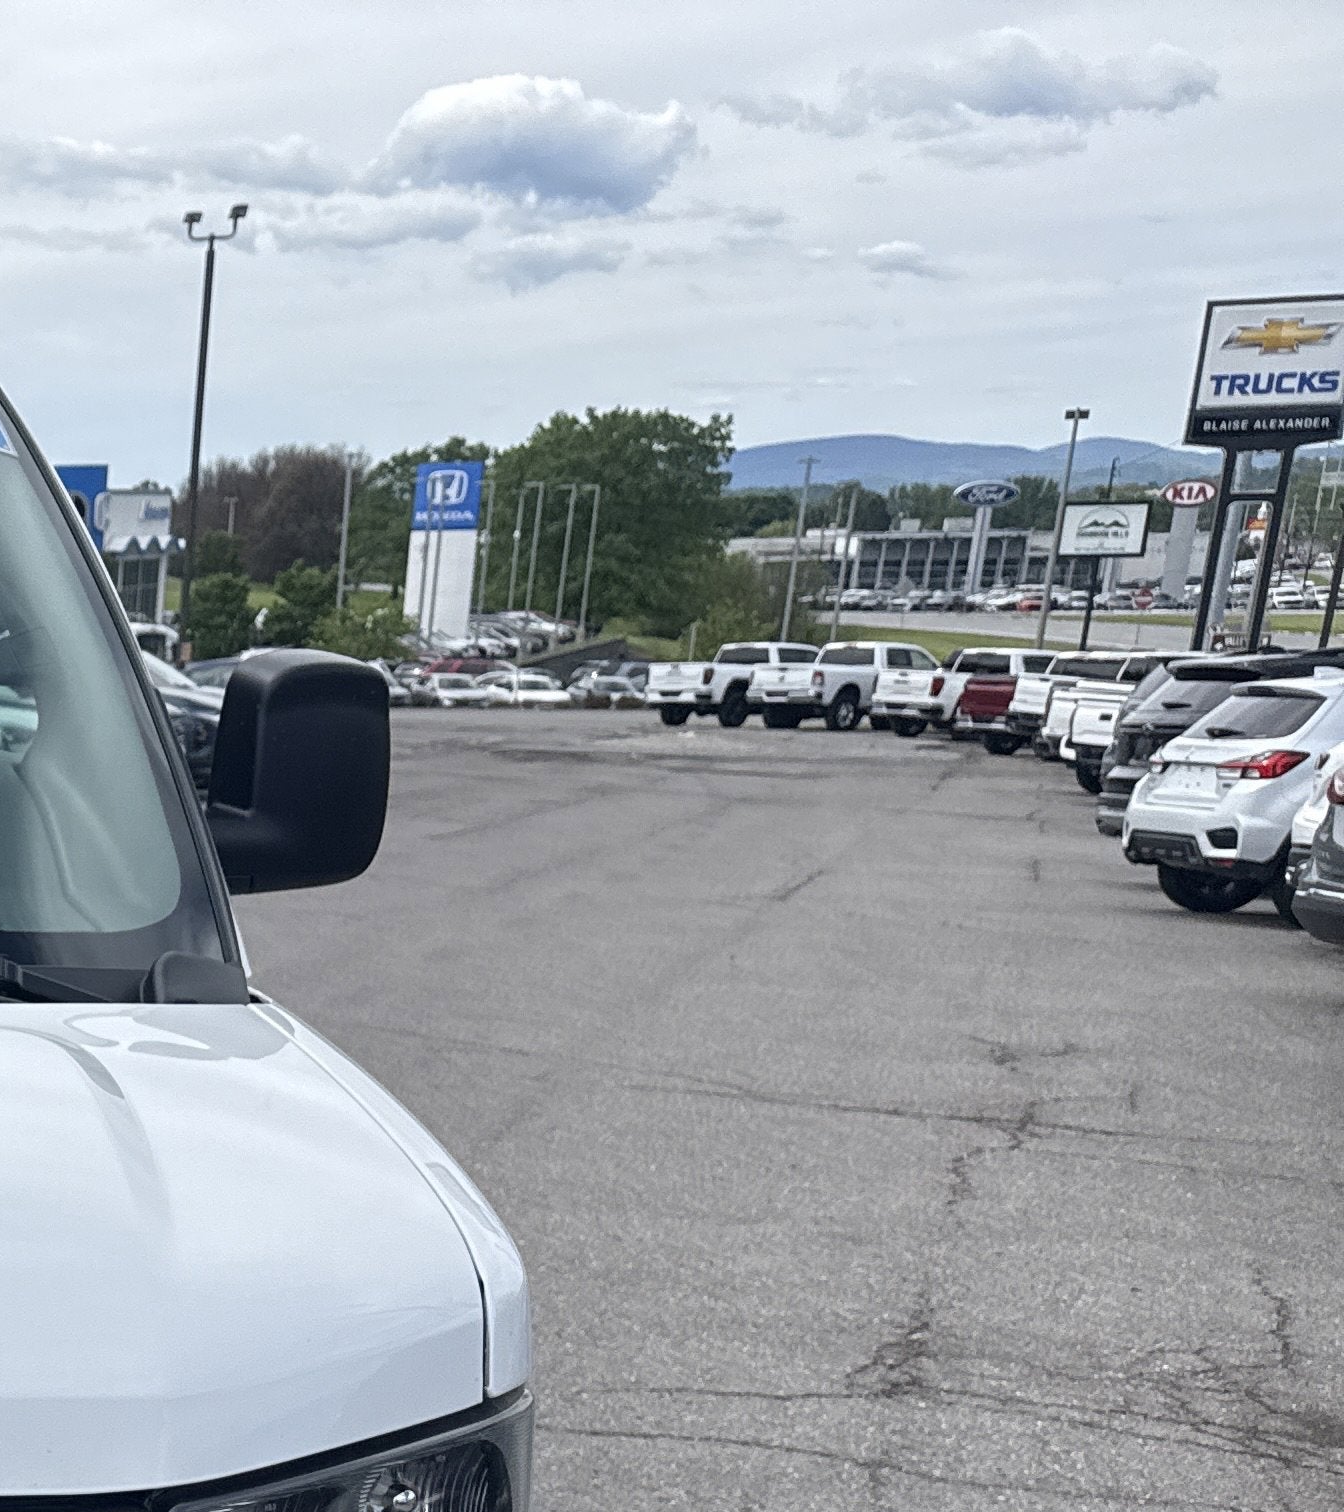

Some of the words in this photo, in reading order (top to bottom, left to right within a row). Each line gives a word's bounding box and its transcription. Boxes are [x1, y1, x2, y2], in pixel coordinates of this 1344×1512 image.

[1209, 370, 1340, 396] TRUCKS
[1203, 419, 1249, 432] BLAISE
[1253, 416, 1331, 430] ALEXANDER
[1172, 481, 1208, 500] KIA
